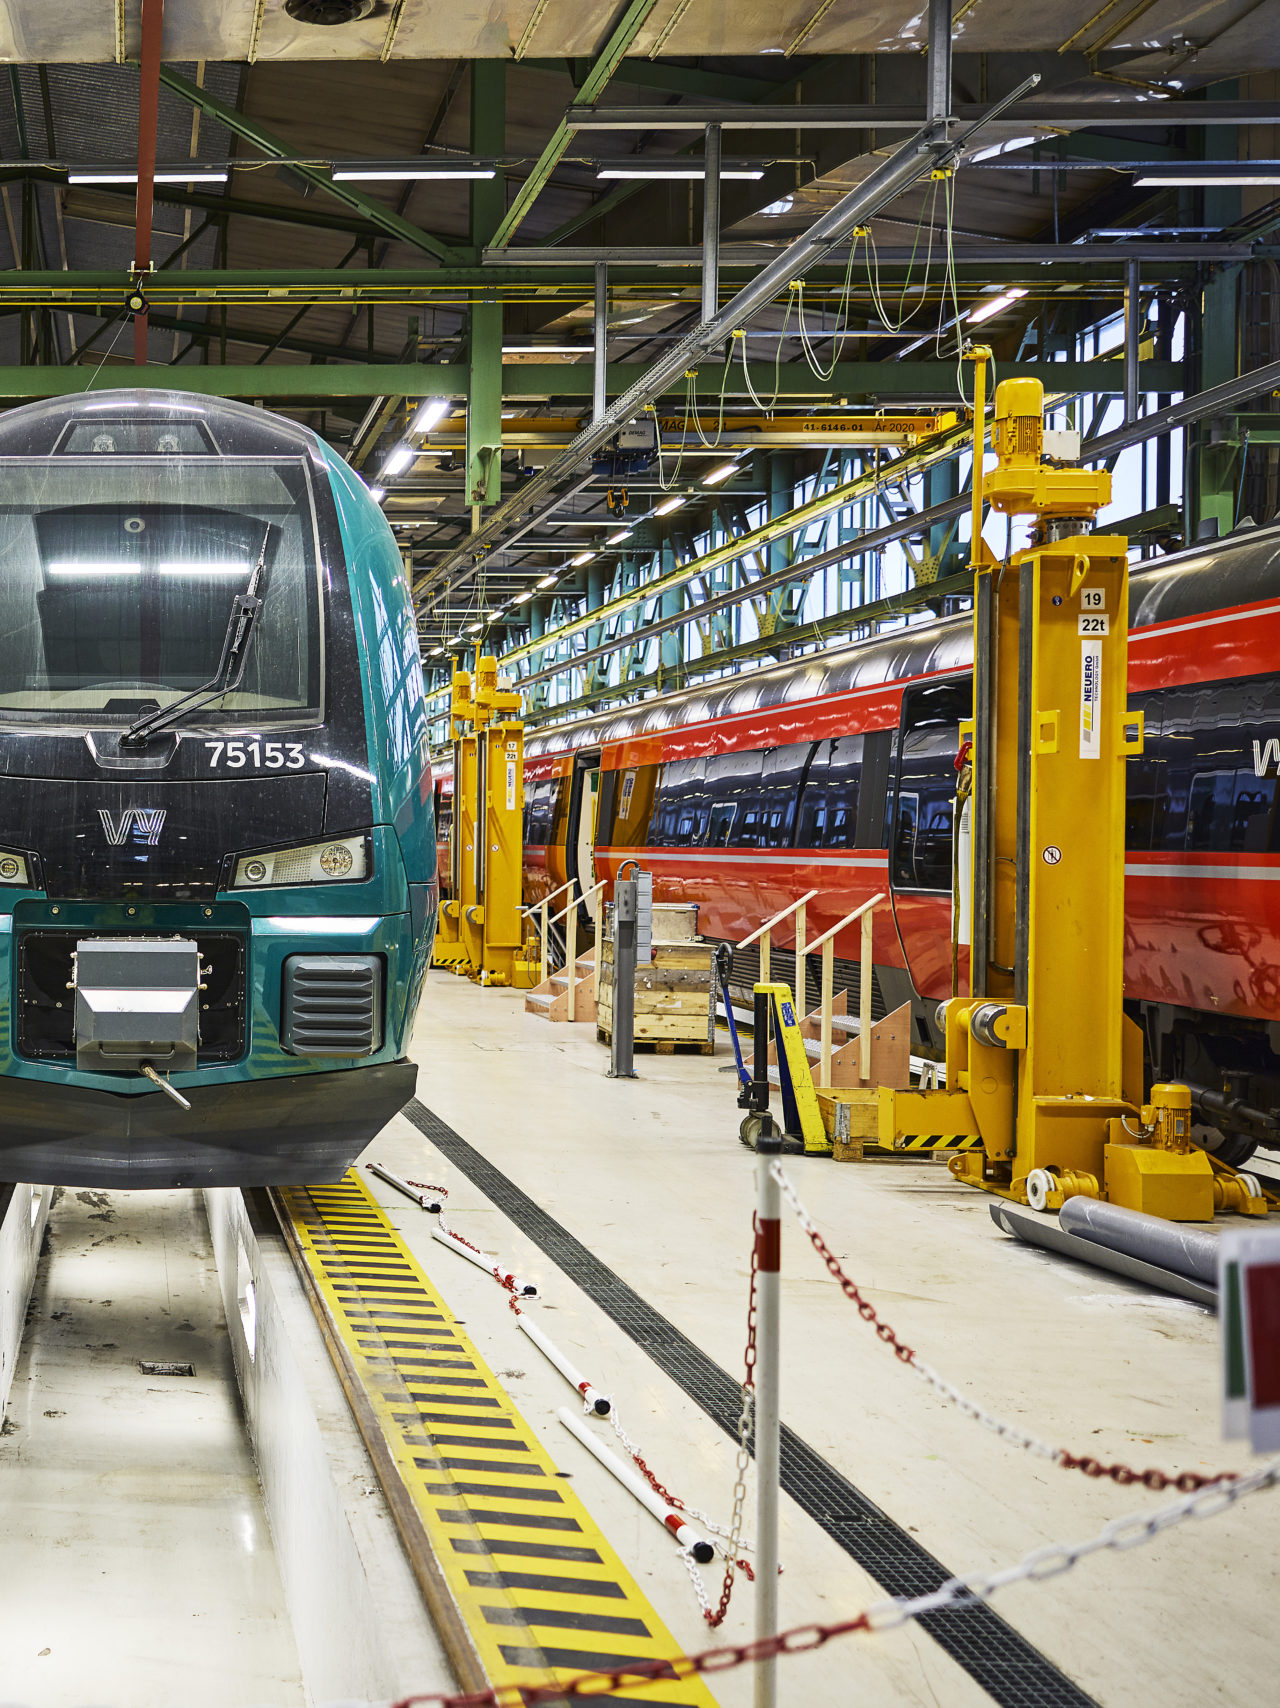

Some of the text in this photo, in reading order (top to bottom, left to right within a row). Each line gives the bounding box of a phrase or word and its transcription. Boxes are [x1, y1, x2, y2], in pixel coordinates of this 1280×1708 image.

[874, 421, 889, 432] År
[889, 423, 915, 432] 2020
[1084, 592, 1102, 606] 19
[1082, 618, 1105, 631] 22t
[1083, 655, 1093, 702] NEUERO
[204, 741, 305, 769] 75153
